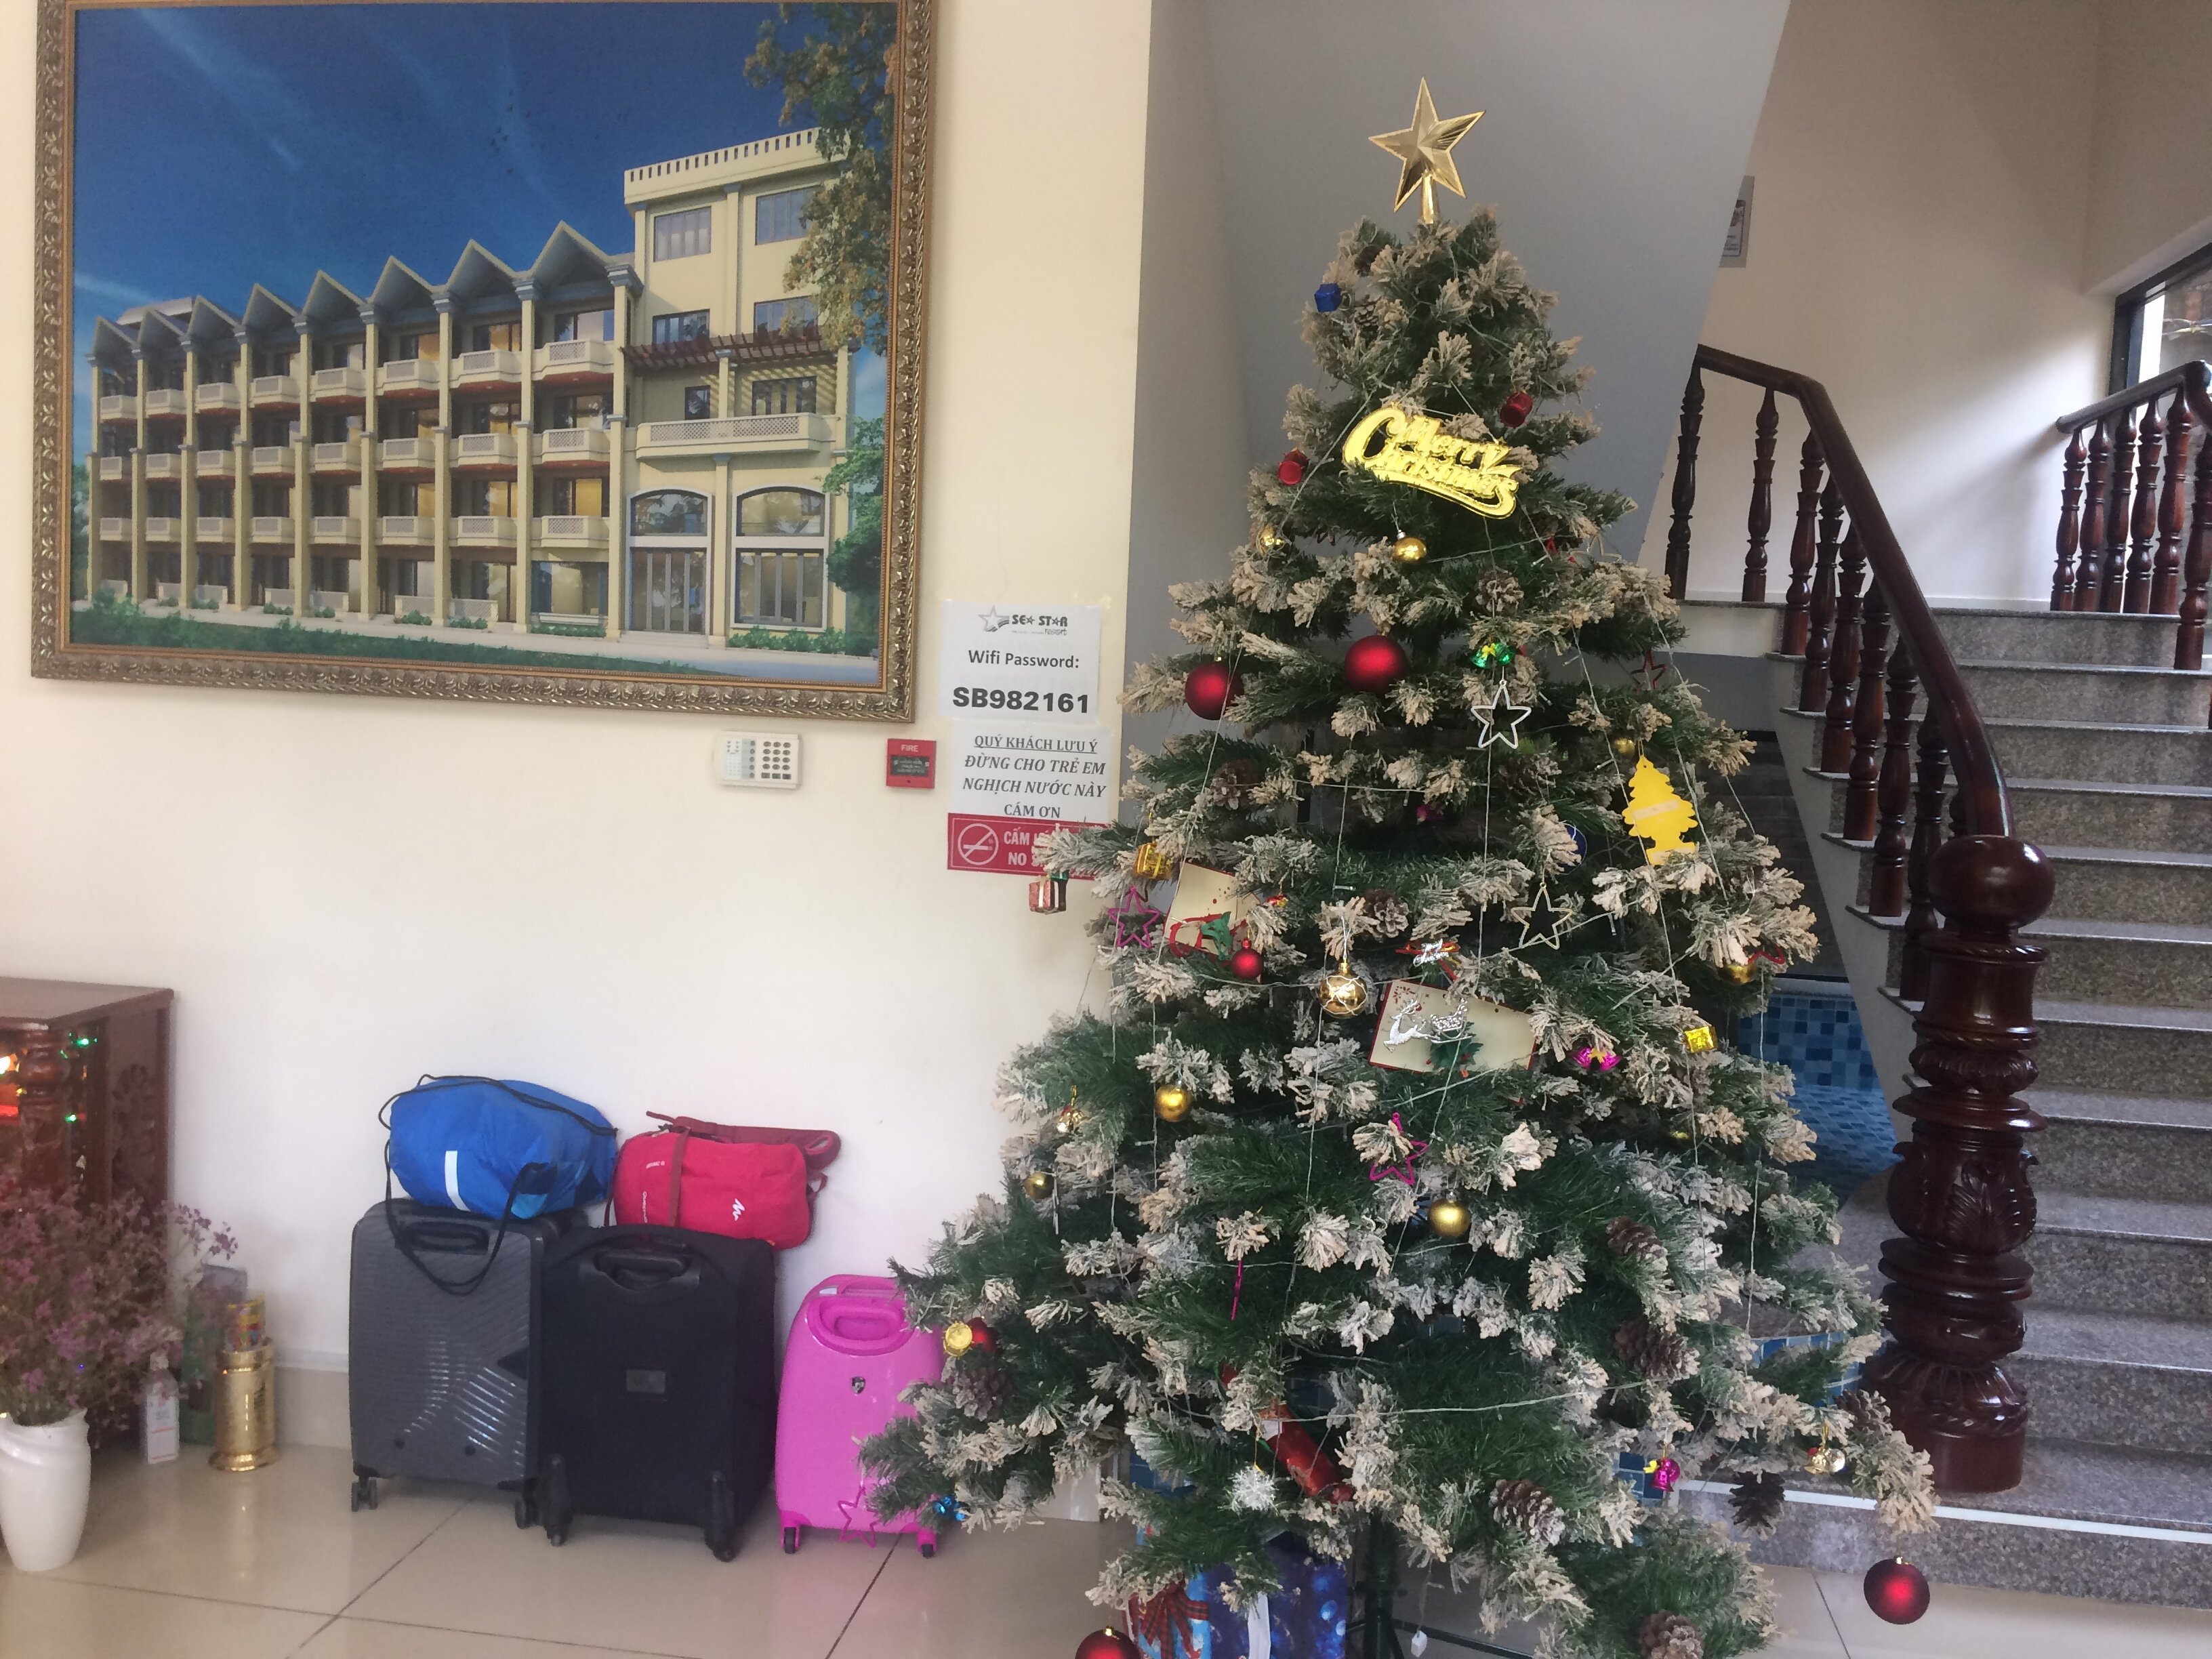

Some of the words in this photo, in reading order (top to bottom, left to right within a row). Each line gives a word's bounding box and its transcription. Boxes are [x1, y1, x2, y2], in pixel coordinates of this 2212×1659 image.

[1044, 628, 1067, 636] resort
[968, 650, 1000, 665] Wifi
[1005, 653, 1079, 668] Password:
[953, 687, 1088, 714] SB982161
[901, 744, 919, 752] FIRE
[975, 734, 1003, 749] QUÝ
[1006, 735, 1052, 750] KHÁCH
[1057, 739, 1086, 752] LƯU
[1089, 739, 1098, 752] Ý
[964, 752, 1010, 770] ĐỪNG
[1014, 758, 1046, 771] CHO
[1050, 757, 1080, 773] TRẺ
[1082, 762, 1107, 775] EM
[963, 777, 1022, 795] NGHỊCH
[1024, 779, 1072, 796] NƯỚC
[1073, 781, 1107, 798] NÀY
[1004, 802, 1035, 817] CÁM
[1039, 806, 1061, 819] ƠN
[1004, 826, 1030, 846] CẤM
[1008, 852, 1027, 866] NO
